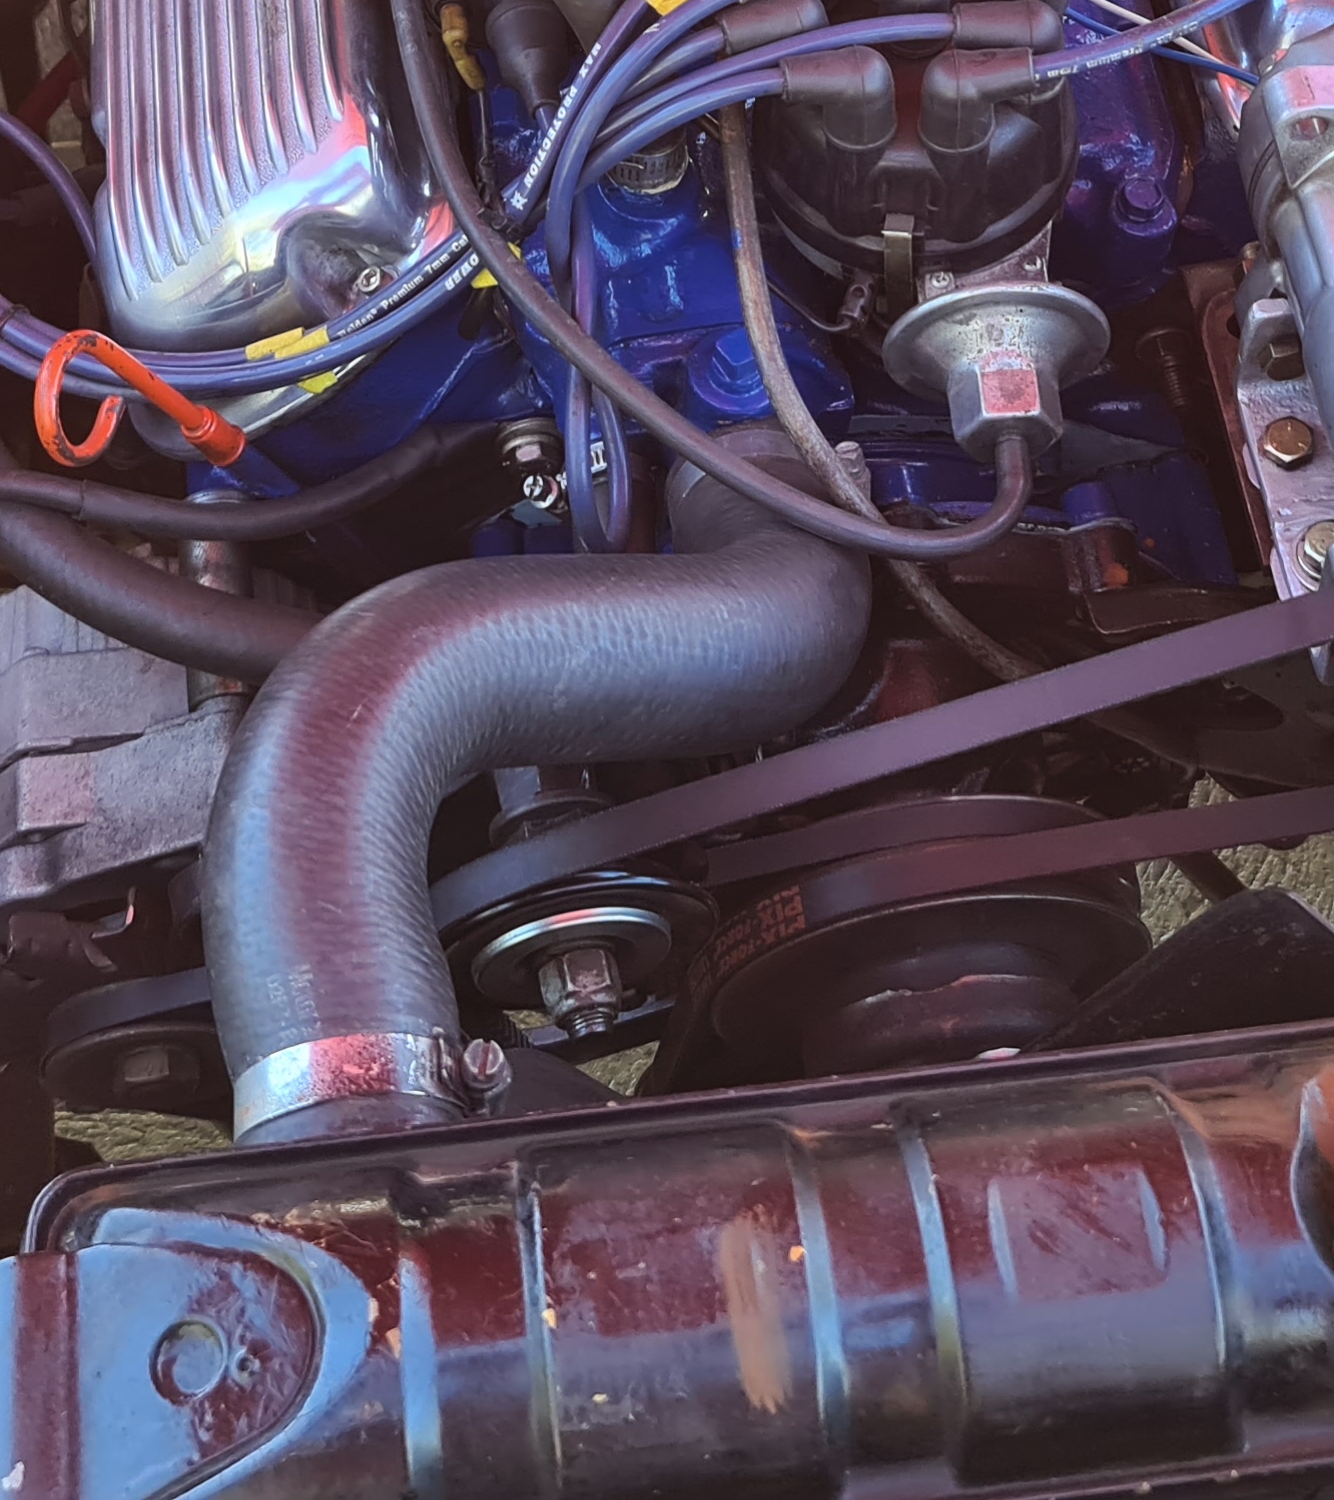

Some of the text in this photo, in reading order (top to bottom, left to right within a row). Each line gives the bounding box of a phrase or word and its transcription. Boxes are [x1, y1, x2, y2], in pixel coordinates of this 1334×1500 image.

[523, 41, 602, 189] MAX PROTECTION
[380, 274, 424, 311] Premium
[424, 254, 451, 275] 7mm
